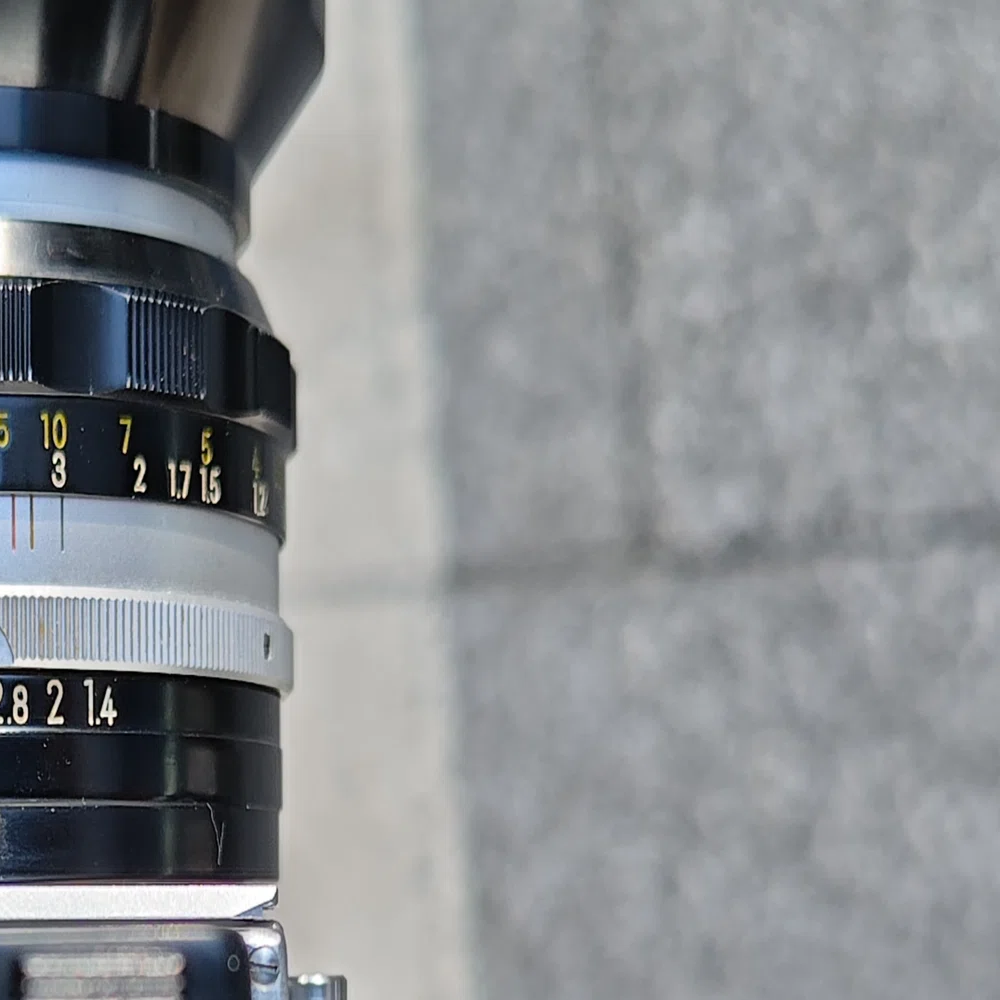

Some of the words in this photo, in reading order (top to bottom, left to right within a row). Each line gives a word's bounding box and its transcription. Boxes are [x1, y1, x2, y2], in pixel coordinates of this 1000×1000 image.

[40, 412, 67, 450] 10
[118, 417, 132, 454] 7
[200, 427, 214, 466] 5
[51, 450, 67, 488] 3
[132, 456, 148, 496] 2
[46, 678, 65, 726] 2
[83, 678, 118, 727] 1.4
